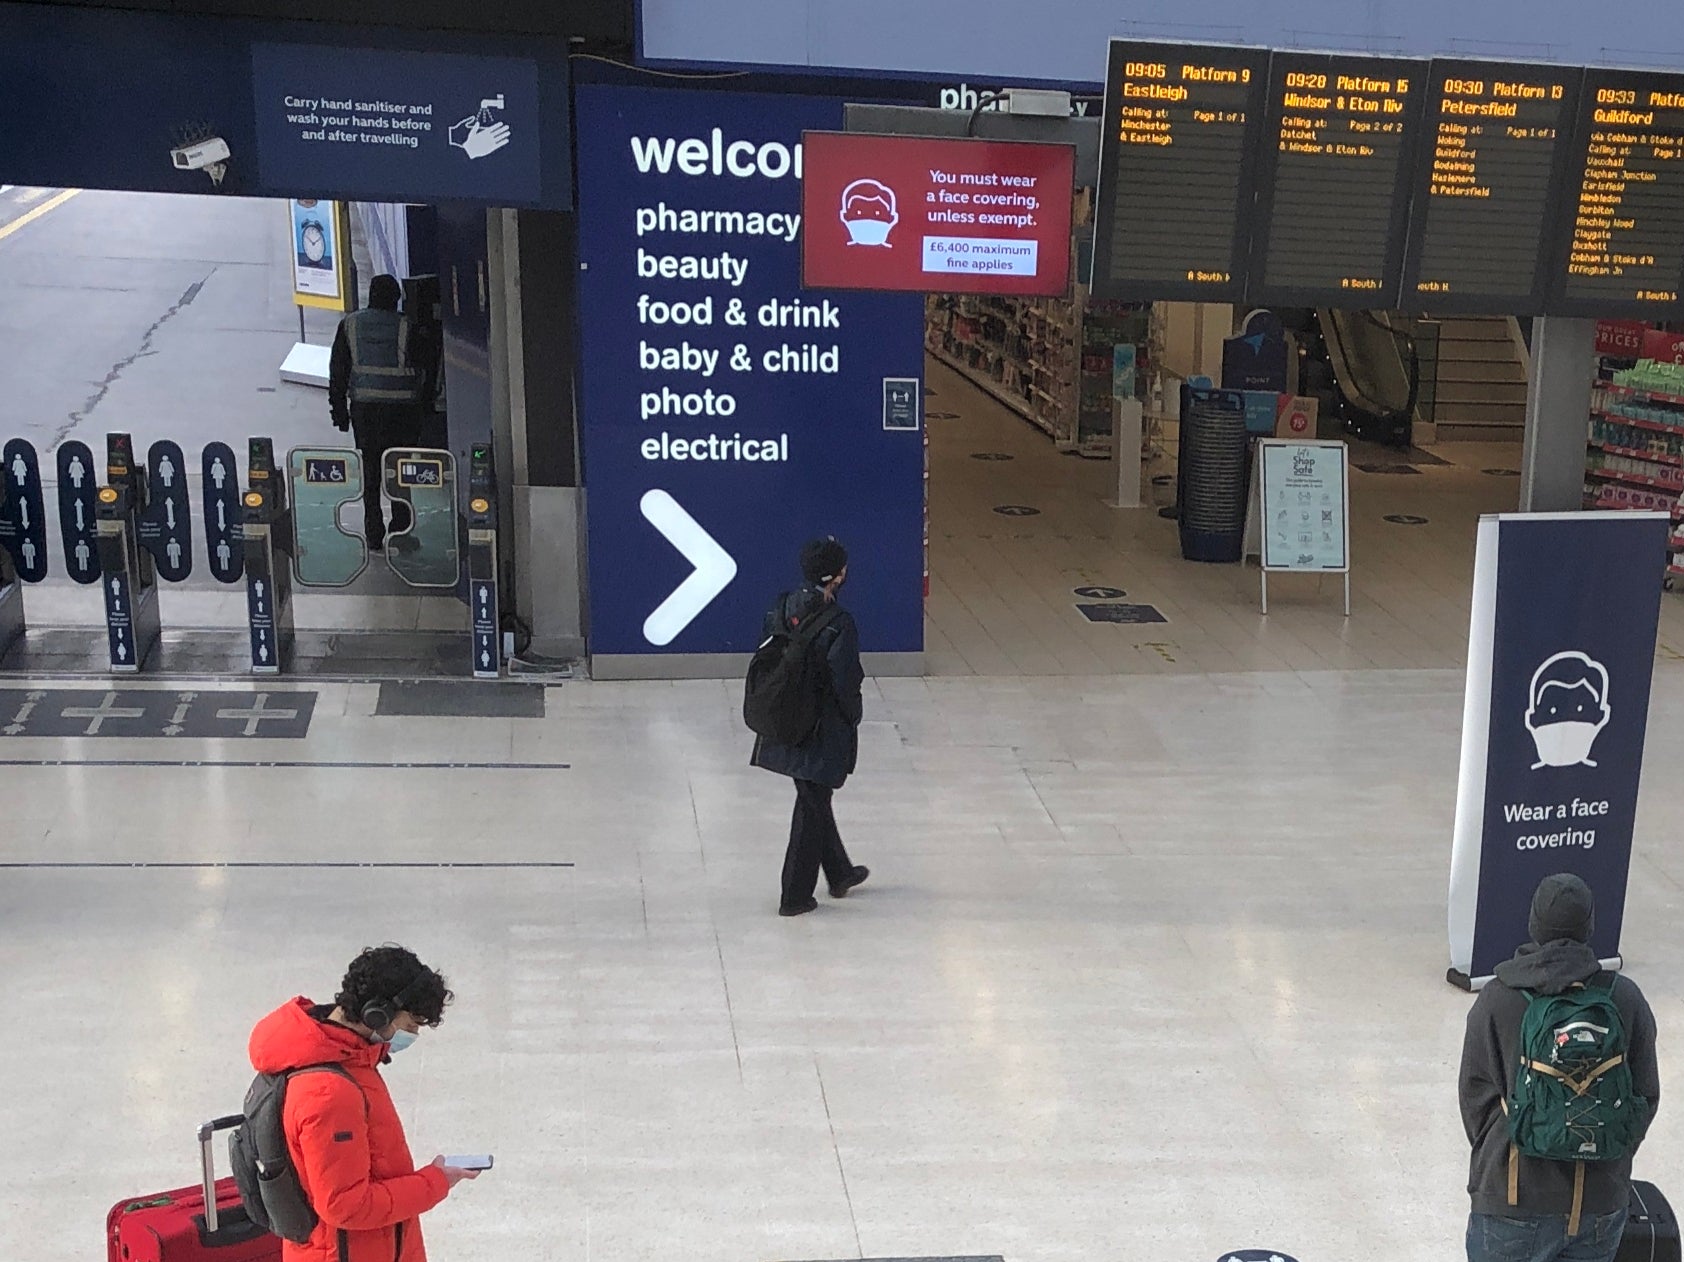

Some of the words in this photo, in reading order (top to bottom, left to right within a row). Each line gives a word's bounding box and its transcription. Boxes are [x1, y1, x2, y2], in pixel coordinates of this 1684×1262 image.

[1126, 63, 1166, 78] 09:05
[1182, 65, 1236, 82] Platform
[1242, 69, 1250, 82] 9
[1124, 83, 1187, 101] Eastleigh
[1337, 76, 1390, 92] Platform
[1397, 79, 1408, 93] 15
[1444, 79, 1483, 95] 09:30
[1494, 82, 1545, 98] Platform
[1552, 86, 1563, 99] 13
[285, 96, 318, 110] Carry
[321, 98, 352, 110] hand
[355, 101, 406, 113] sanitiser
[409, 104, 432, 115] and
[1284, 93, 1331, 108] Windsor
[1337, 96, 1345, 109] &
[1350, 97, 1379, 112] Eton
[1597, 89, 1635, 104] 09:33
[1442, 99, 1517, 116] Petersfield
[1594, 109, 1653, 124] Guildford
[287, 113, 319, 123] wash
[320, 114, 349, 130] your
[352, 115, 388, 128] hands
[392, 118, 431, 130] before
[302, 129, 325, 140] and
[328, 130, 358, 144] after
[360, 133, 418, 147] travelling
[930, 170, 956, 183] You
[960, 174, 998, 185] must
[1001, 176, 1037, 187] wear
[927, 192, 935, 202] a
[939, 189, 969, 203] face
[973, 193, 1039, 209] covering,
[637, 202, 801, 241] pharmacy
[928, 209, 975, 223] unless
[979, 214, 1037, 228] exempt.
[930, 241, 968, 254] £6,400
[972, 244, 1030, 255] maximum
[638, 248, 748, 286] beauty
[947, 257, 968, 267] fine
[972, 259, 1013, 271] applies
[637, 295, 712, 324] food
[725, 298, 747, 325] &
[758, 298, 839, 327] drink
[640, 341, 719, 376] baby
[730, 344, 752, 371] &
[763, 344, 838, 373] child
[641, 387, 735, 419] photo
[641, 432, 787, 461] electrical
[1293, 456, 1316, 468] Shop
[1293, 465, 1314, 475] Safe
[1504, 804, 1553, 822] Wear
[1557, 805, 1566, 818] a
[1571, 798, 1608, 816] face
[1517, 827, 1595, 850] covering
